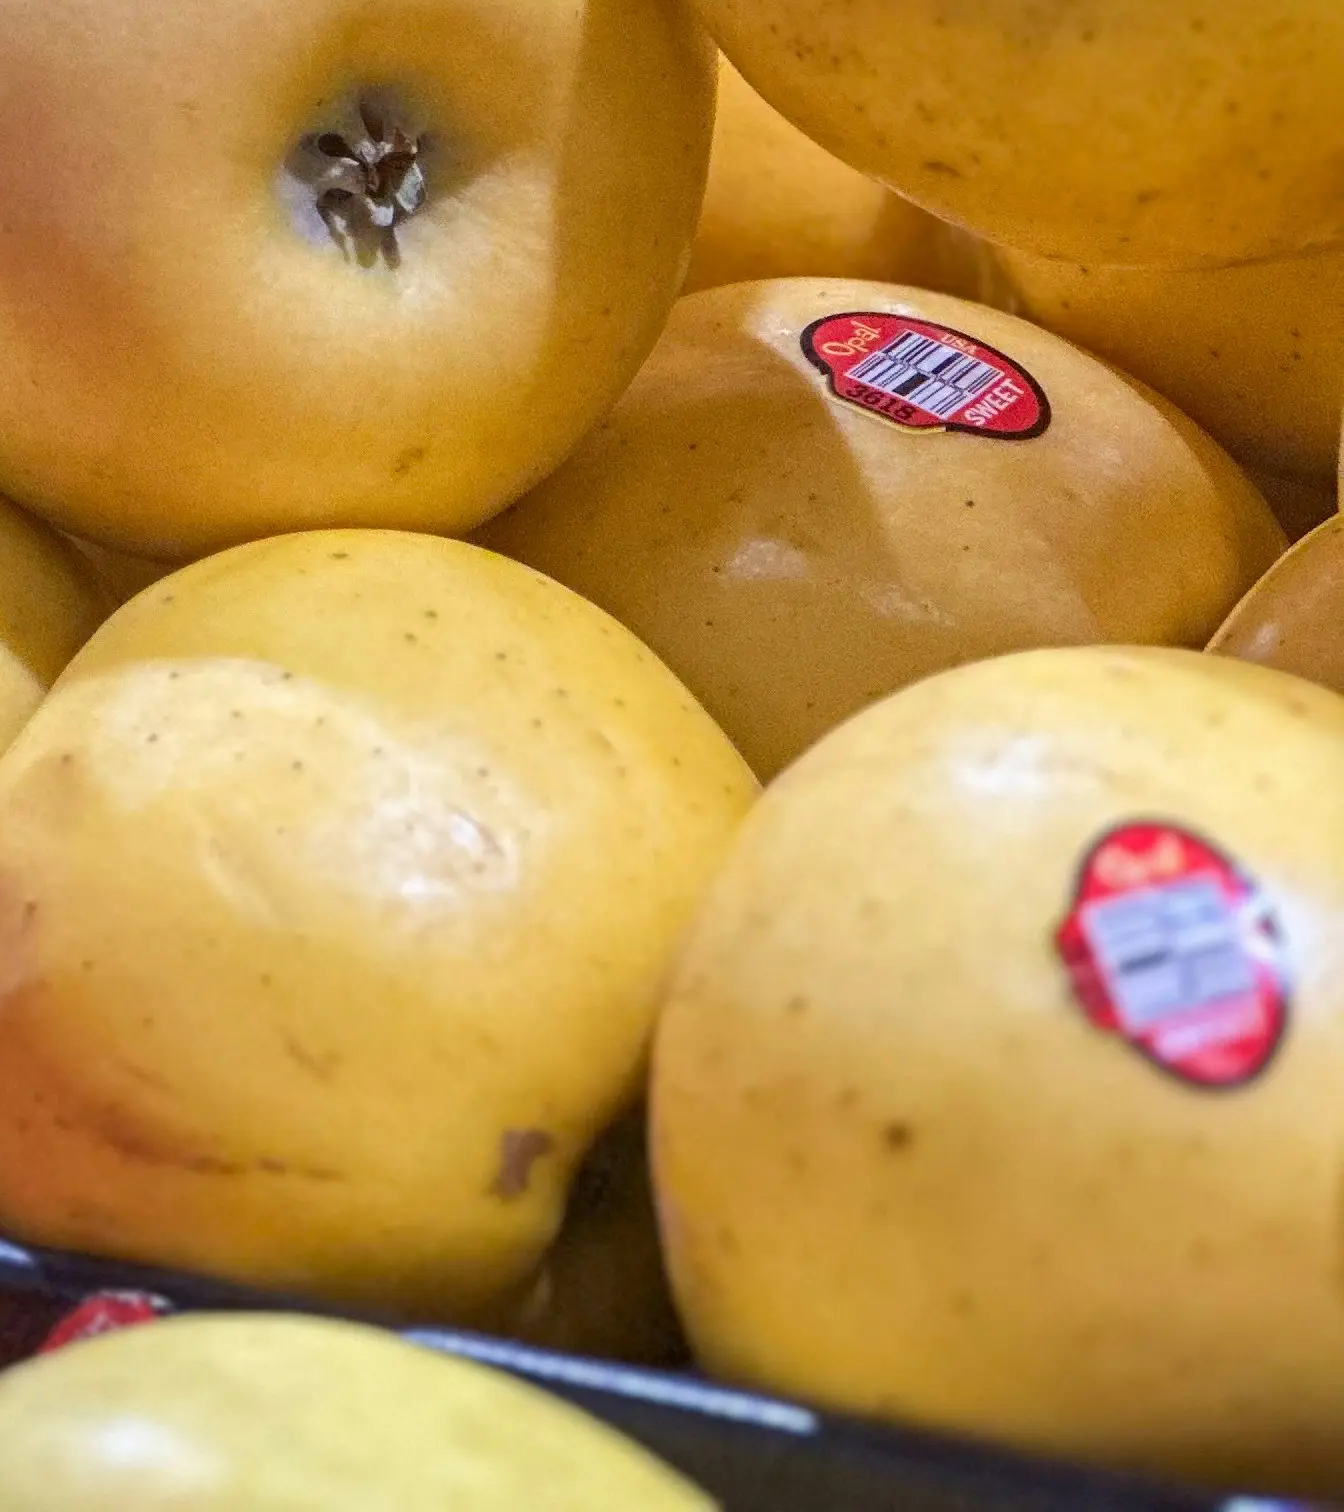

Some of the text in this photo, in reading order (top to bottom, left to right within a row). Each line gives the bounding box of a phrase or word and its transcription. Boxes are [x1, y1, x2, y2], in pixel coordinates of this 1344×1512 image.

[822, 321, 882, 356] Opal
[940, 333, 978, 355] USA
[846, 384, 918, 421] 3618
[964, 378, 1025, 426] SWEET
